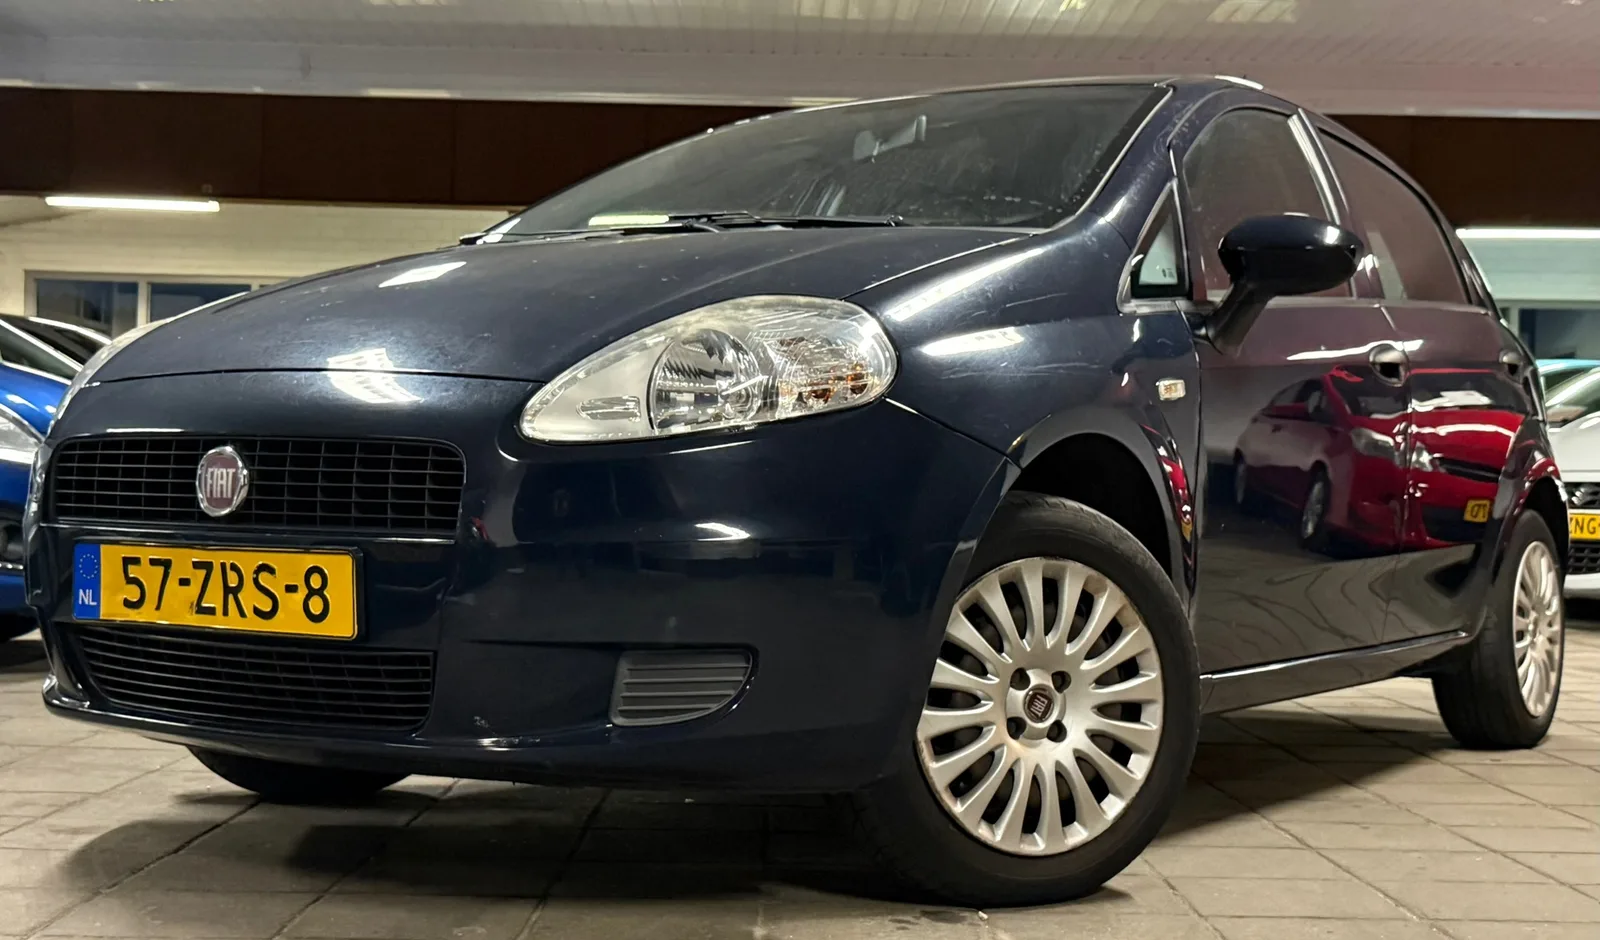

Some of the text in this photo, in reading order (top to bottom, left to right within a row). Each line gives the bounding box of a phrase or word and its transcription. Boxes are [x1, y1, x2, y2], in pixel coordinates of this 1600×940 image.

[207, 468, 236, 498] FIAT
[78, 588, 98, 605] NL
[121, 555, 331, 624] 57-ZRS-8
[1030, 694, 1048, 717] FIAT
